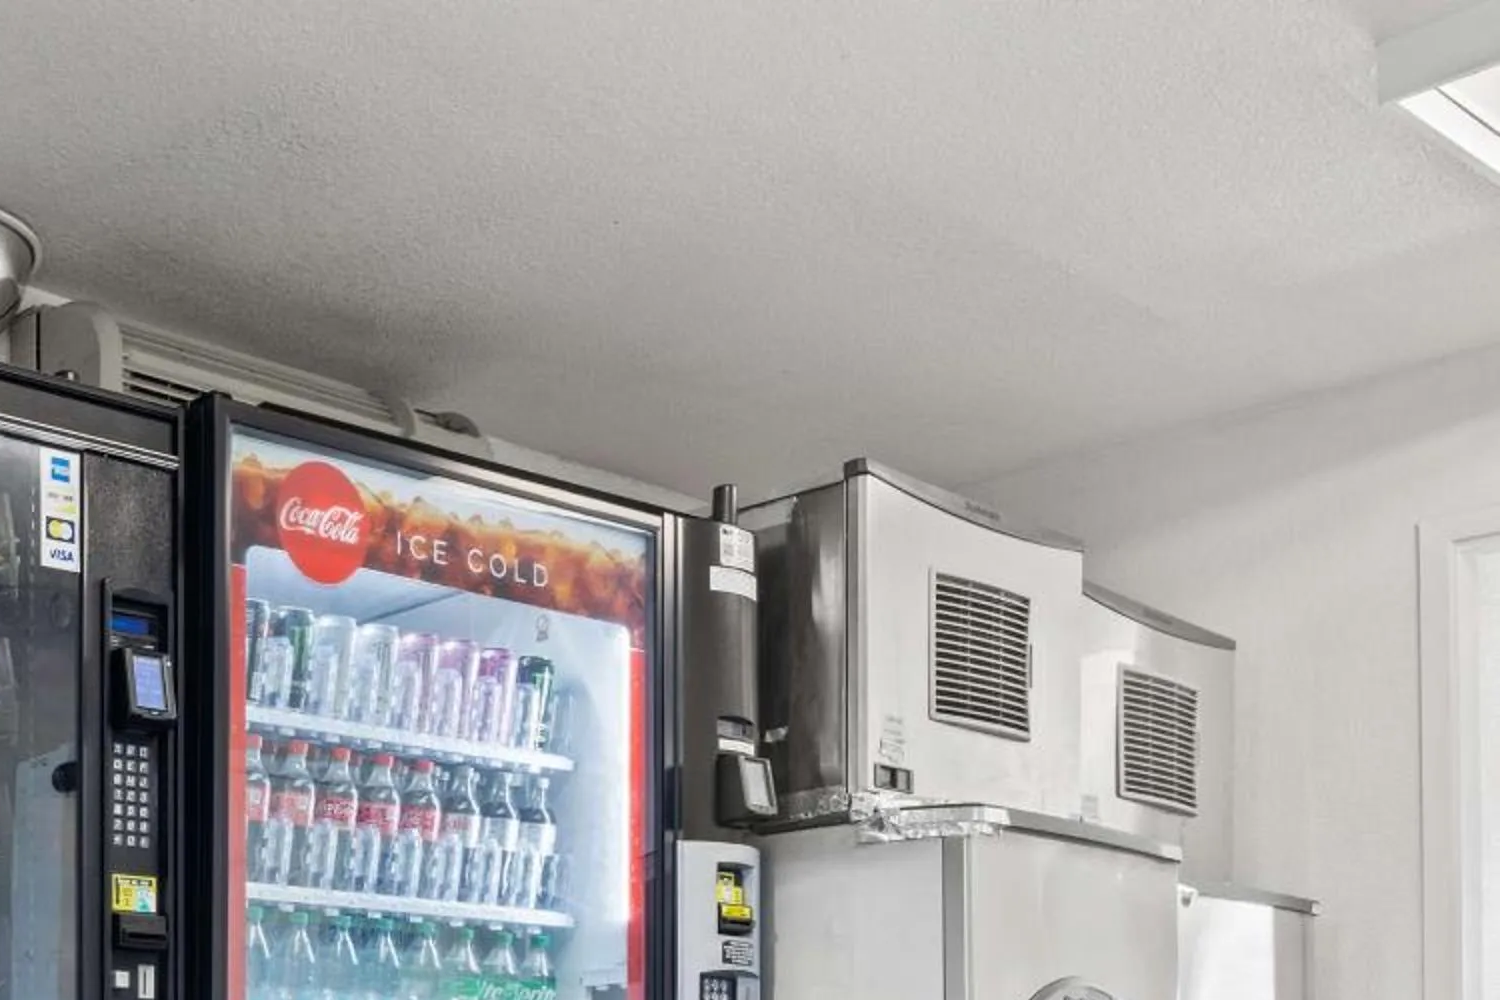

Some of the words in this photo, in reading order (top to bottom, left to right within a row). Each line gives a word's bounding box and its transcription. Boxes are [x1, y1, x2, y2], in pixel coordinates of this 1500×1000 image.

[49, 548, 74, 563] VISA
[396, 530, 449, 566] ICE
[467, 547, 550, 588] COLD
